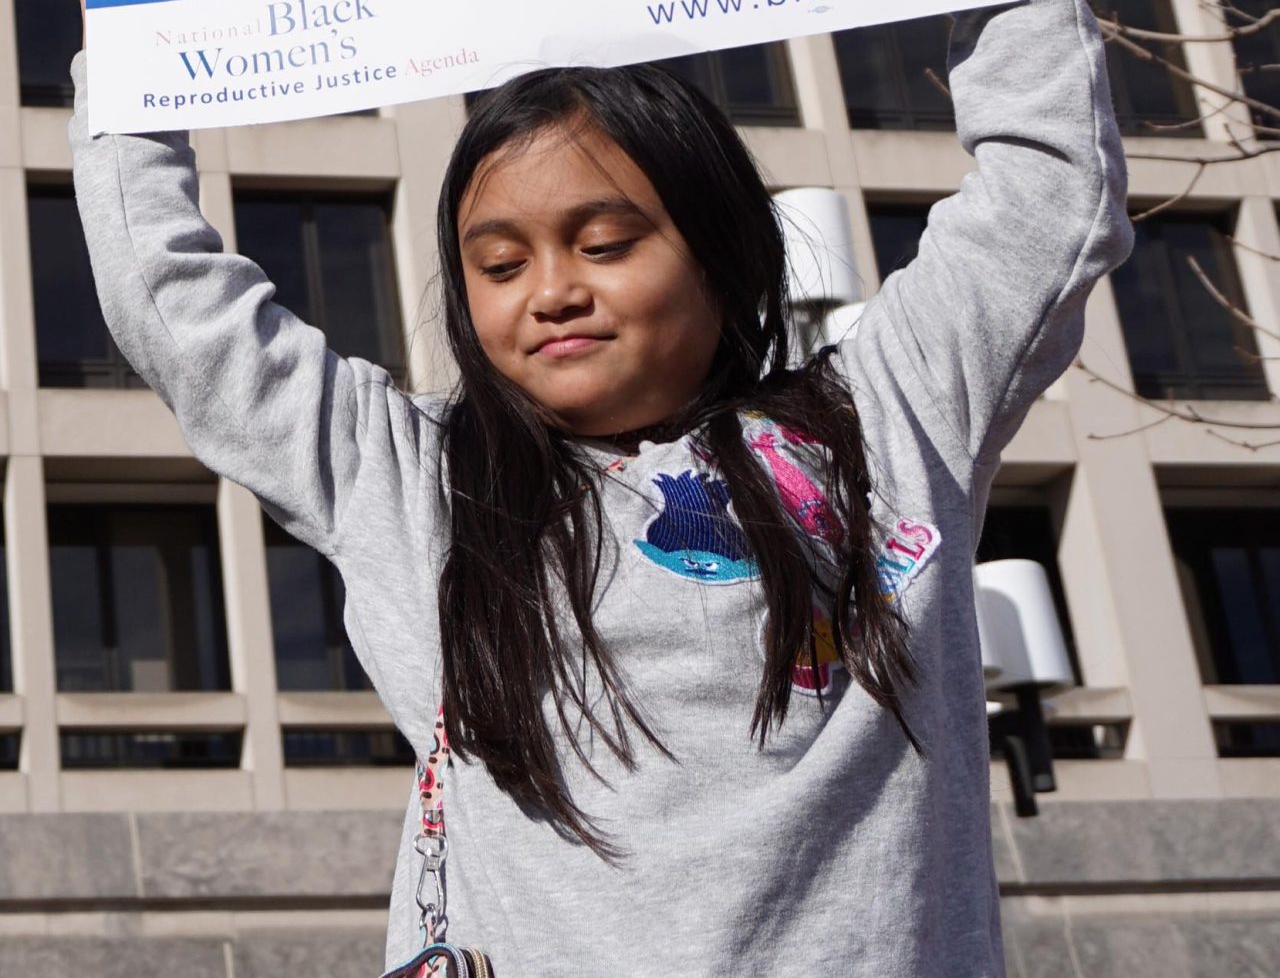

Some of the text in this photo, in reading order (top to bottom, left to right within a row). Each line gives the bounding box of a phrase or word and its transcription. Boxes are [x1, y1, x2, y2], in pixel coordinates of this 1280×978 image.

[155, 18, 262, 47] National
[178, 29, 358, 81] Women's
[143, 47, 480, 109] Reproductive Justice Agenda
